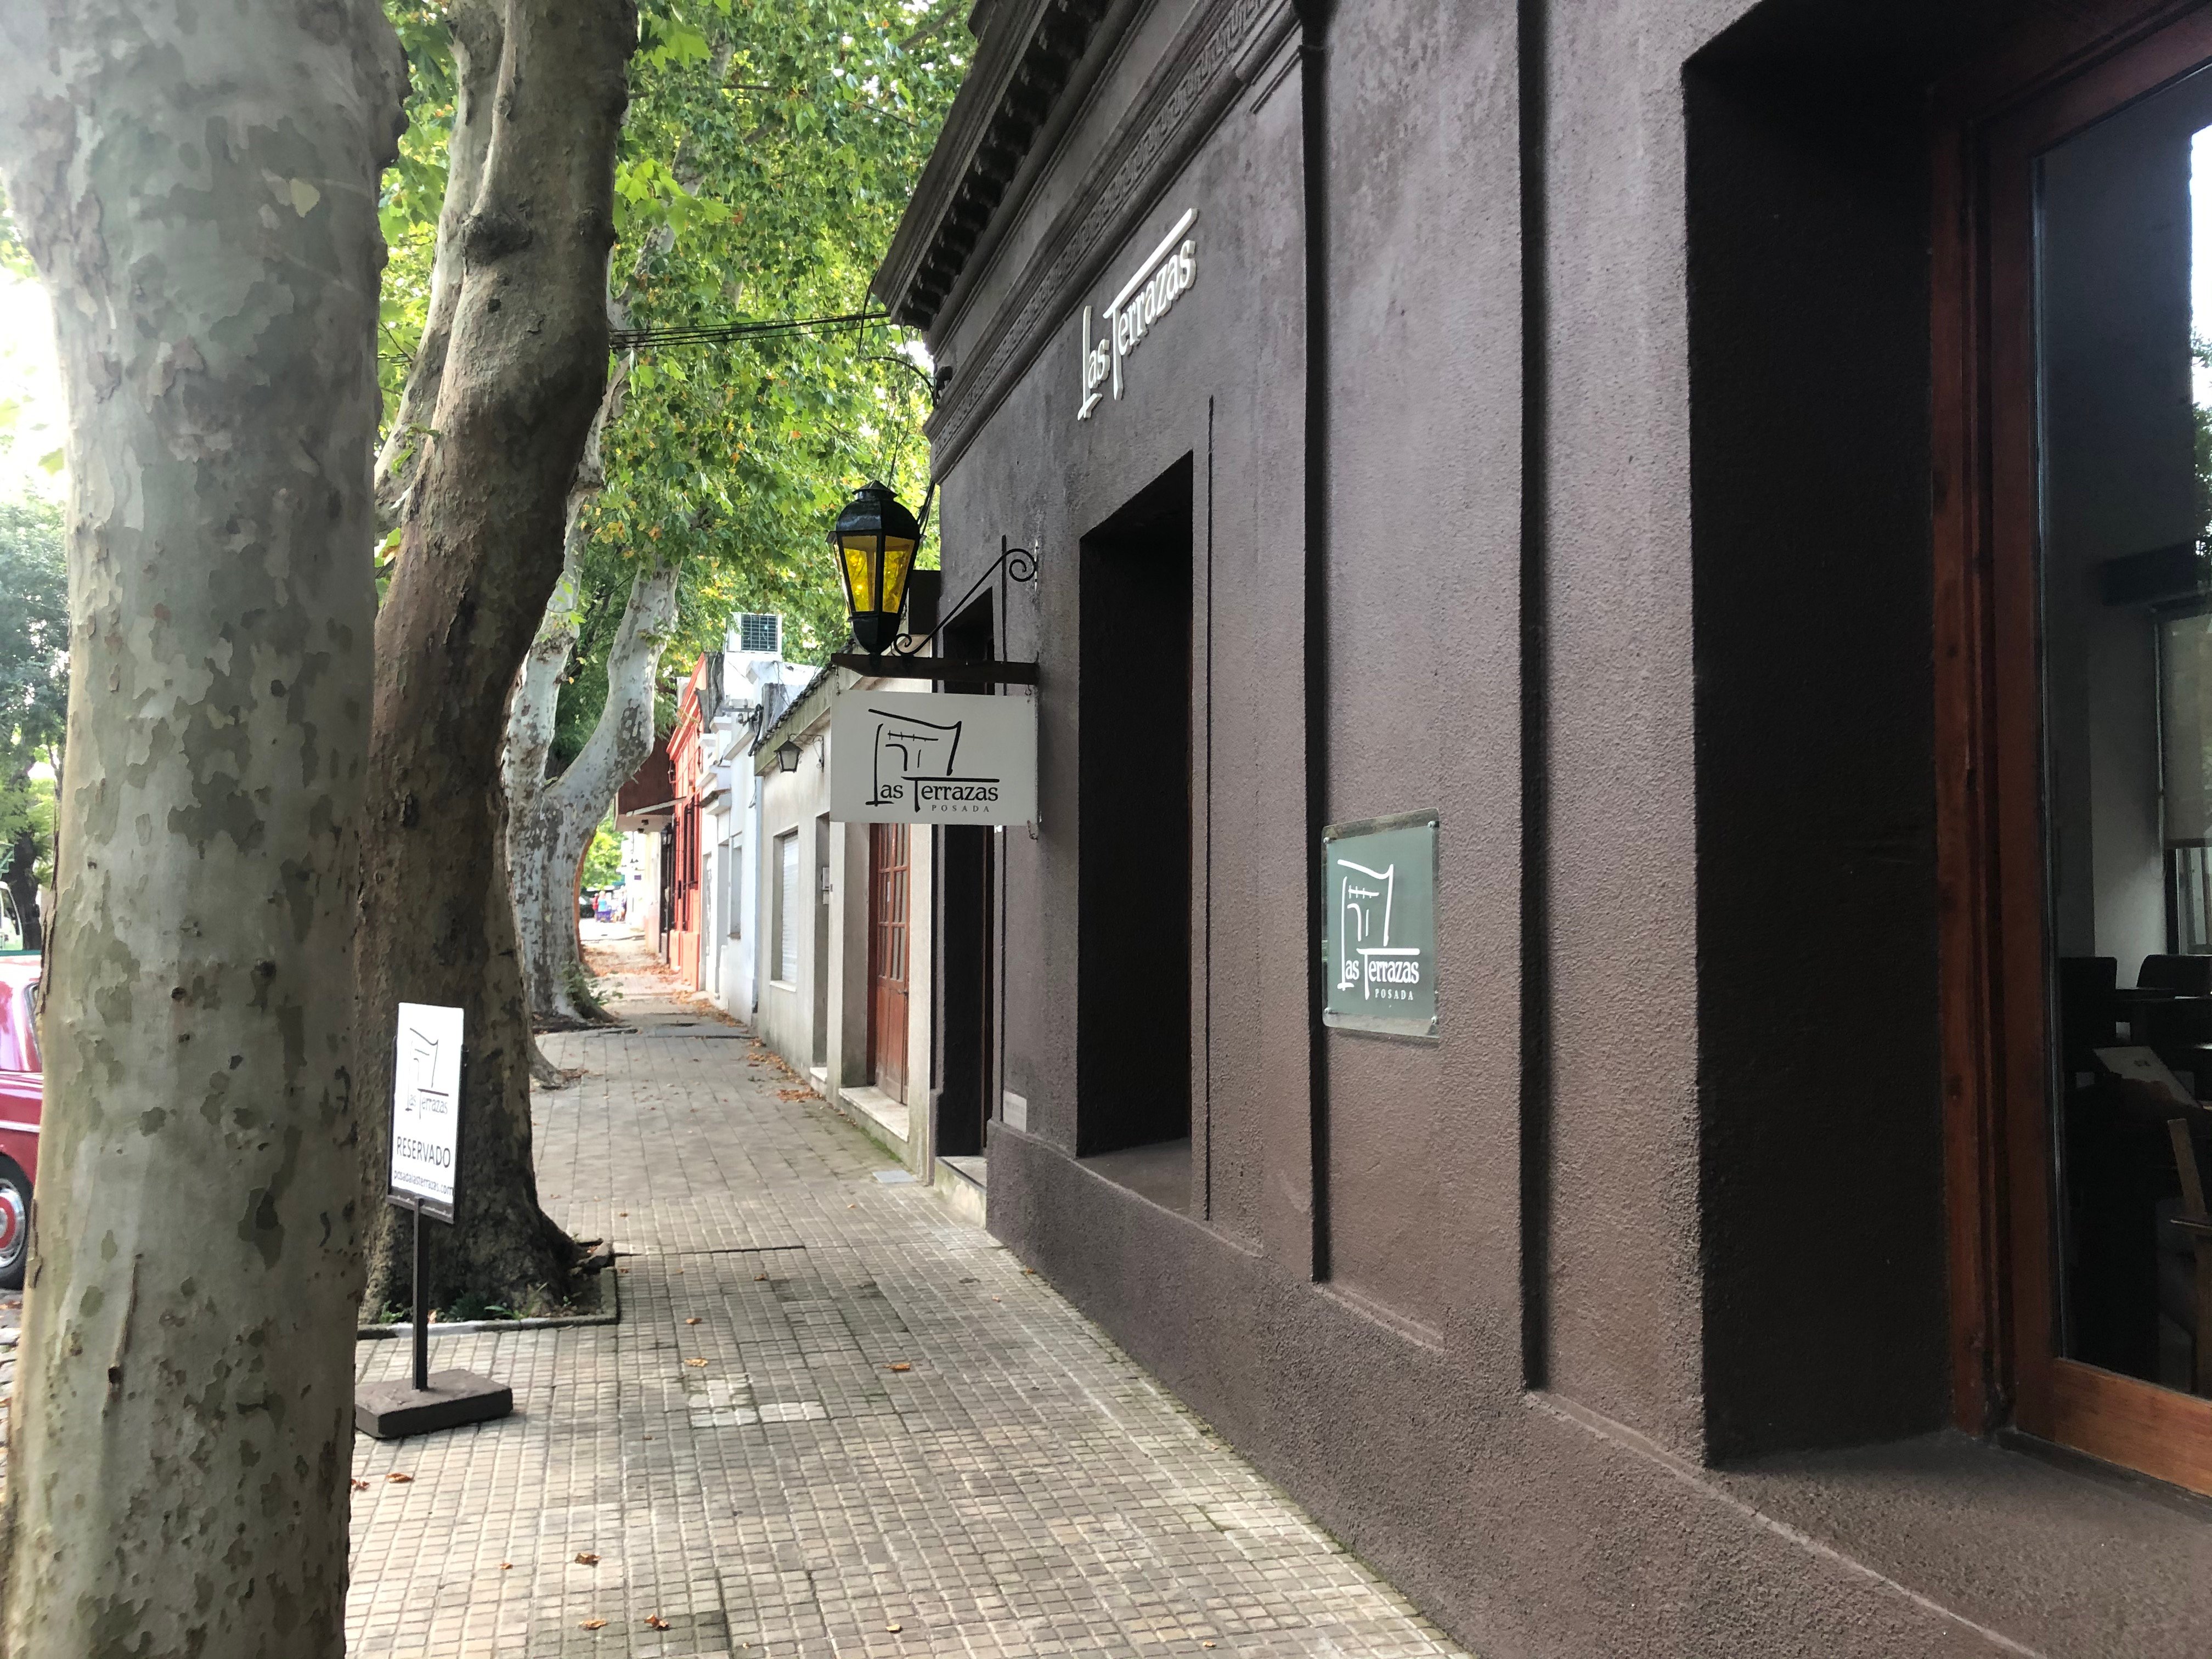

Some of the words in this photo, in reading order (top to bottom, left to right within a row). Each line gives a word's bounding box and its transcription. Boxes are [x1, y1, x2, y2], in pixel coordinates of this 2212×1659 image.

[1077, 305, 1111, 421] Las
[1103, 208, 1198, 400] Terrazas
[901, 776, 1000, 813] Terrazas
[932, 804, 990, 812] POSADA
[1356, 947, 1420, 1000] Terrazas
[1375, 988, 1414, 1001] POSADA
[417, 1087, 449, 1120] Terrazas
[397, 1135, 451, 1169] RESERVADO
